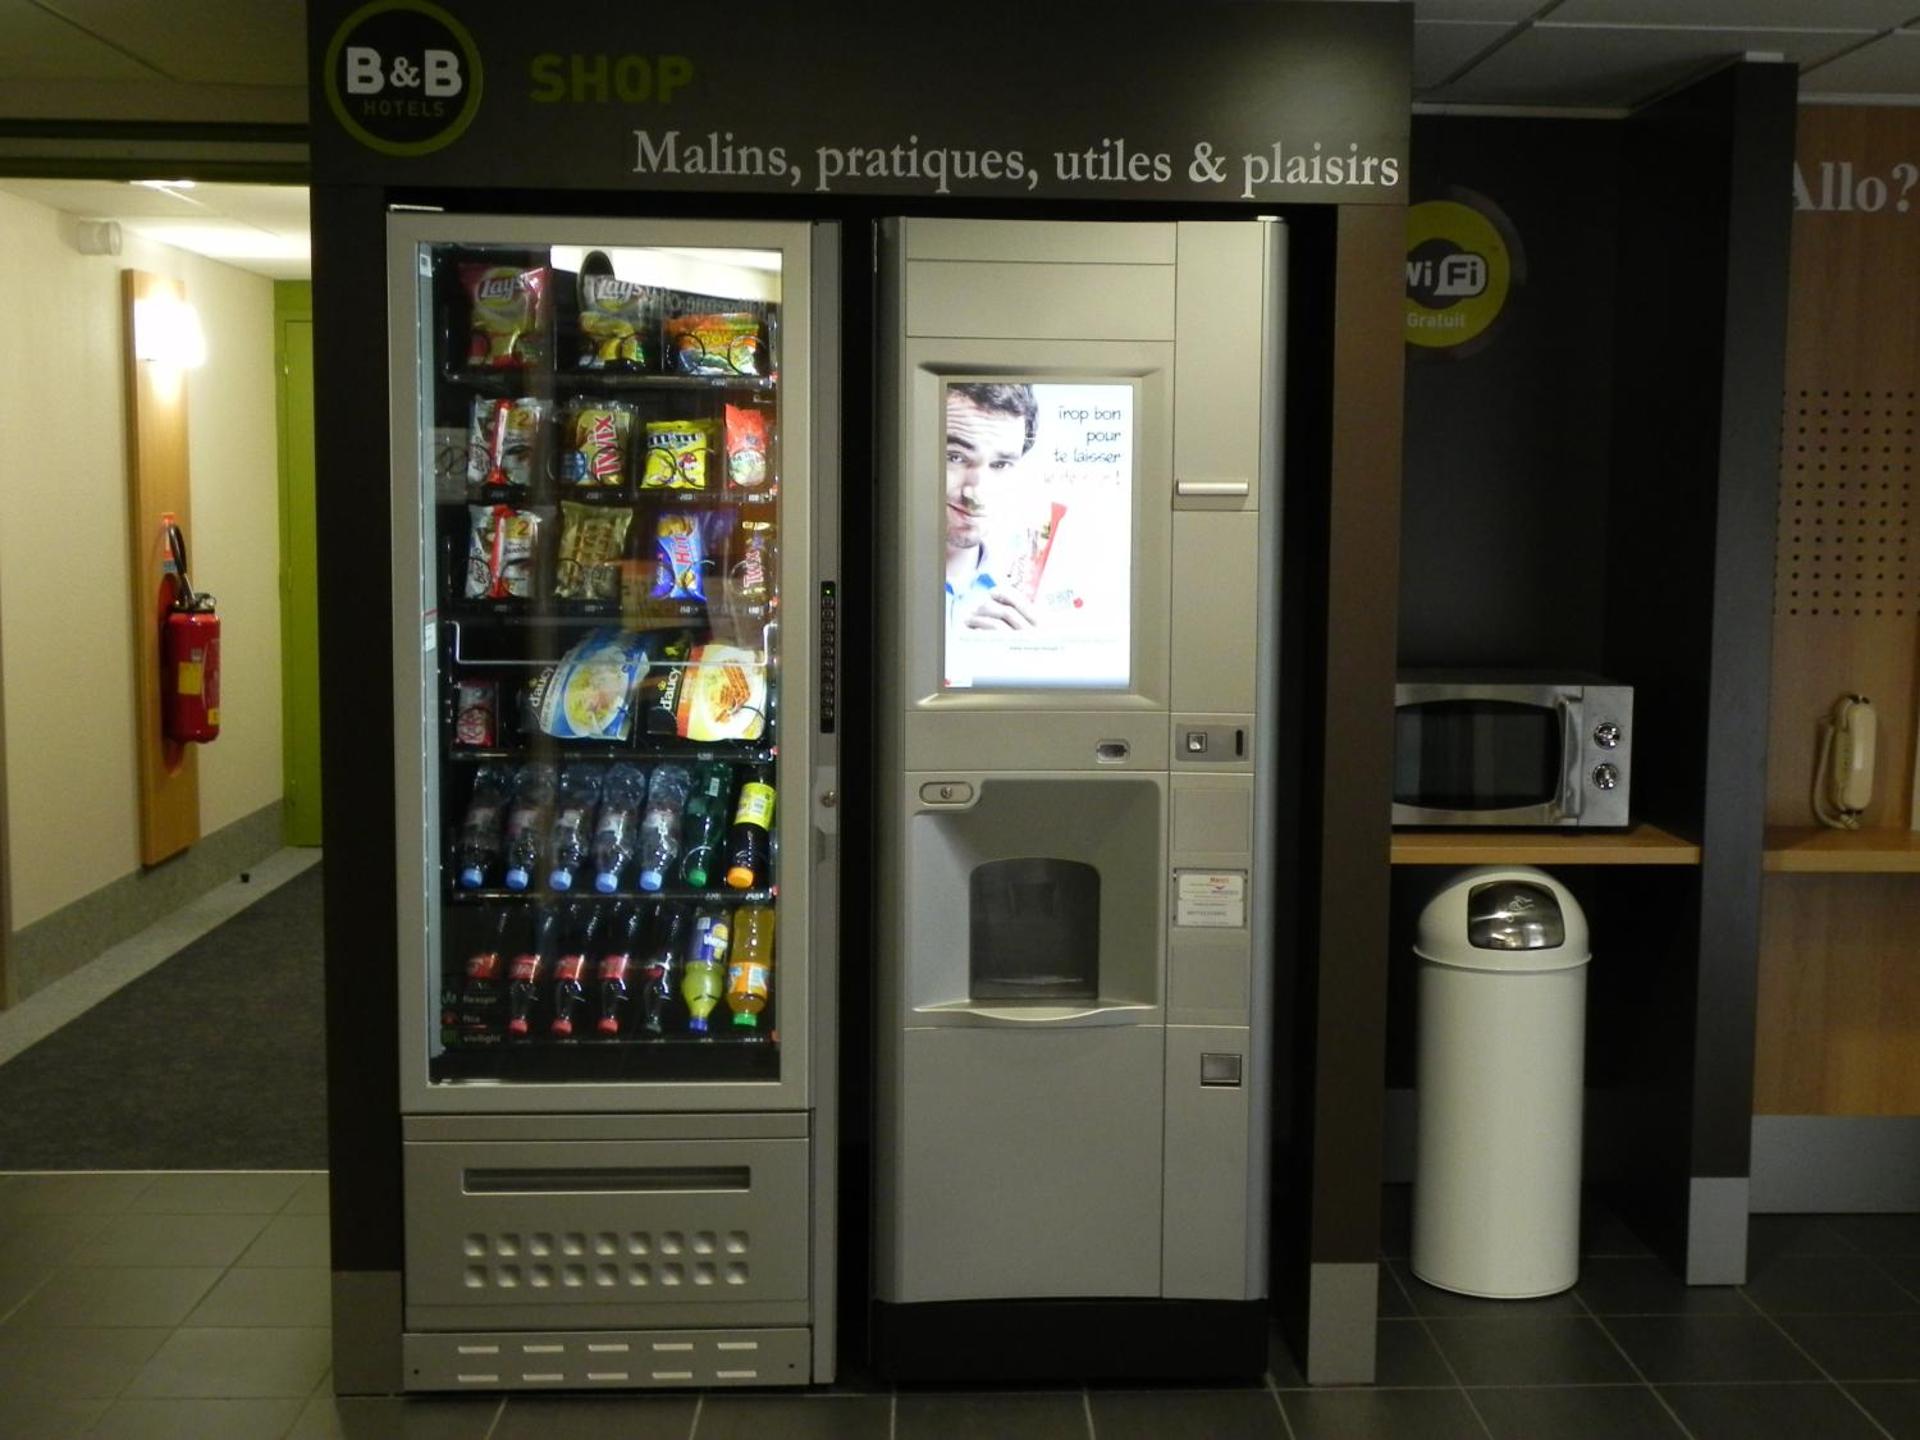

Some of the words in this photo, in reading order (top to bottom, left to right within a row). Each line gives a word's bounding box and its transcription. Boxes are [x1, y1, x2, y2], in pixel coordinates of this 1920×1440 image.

[346, 46, 463, 97] B&B
[529, 53, 694, 102] SHOP
[363, 99, 446, 117] HOTELS
[632, 129, 802, 184] Malins,
[815, 135, 1040, 194] pratiques,
[1054, 137, 1172, 182] utiles
[1187, 141, 1227, 184] &
[1240, 142, 1400, 199] plaisirs
[1791, 160, 1919, 213] Allo?
[1059, 405, 1089, 425] Trop
[1094, 405, 1121, 420] bon
[1086, 431, 1121, 446] pour
[1054, 448, 1067, 463] te
[1073, 447, 1121, 463] laisser
[517, 519, 530, 536] 2
